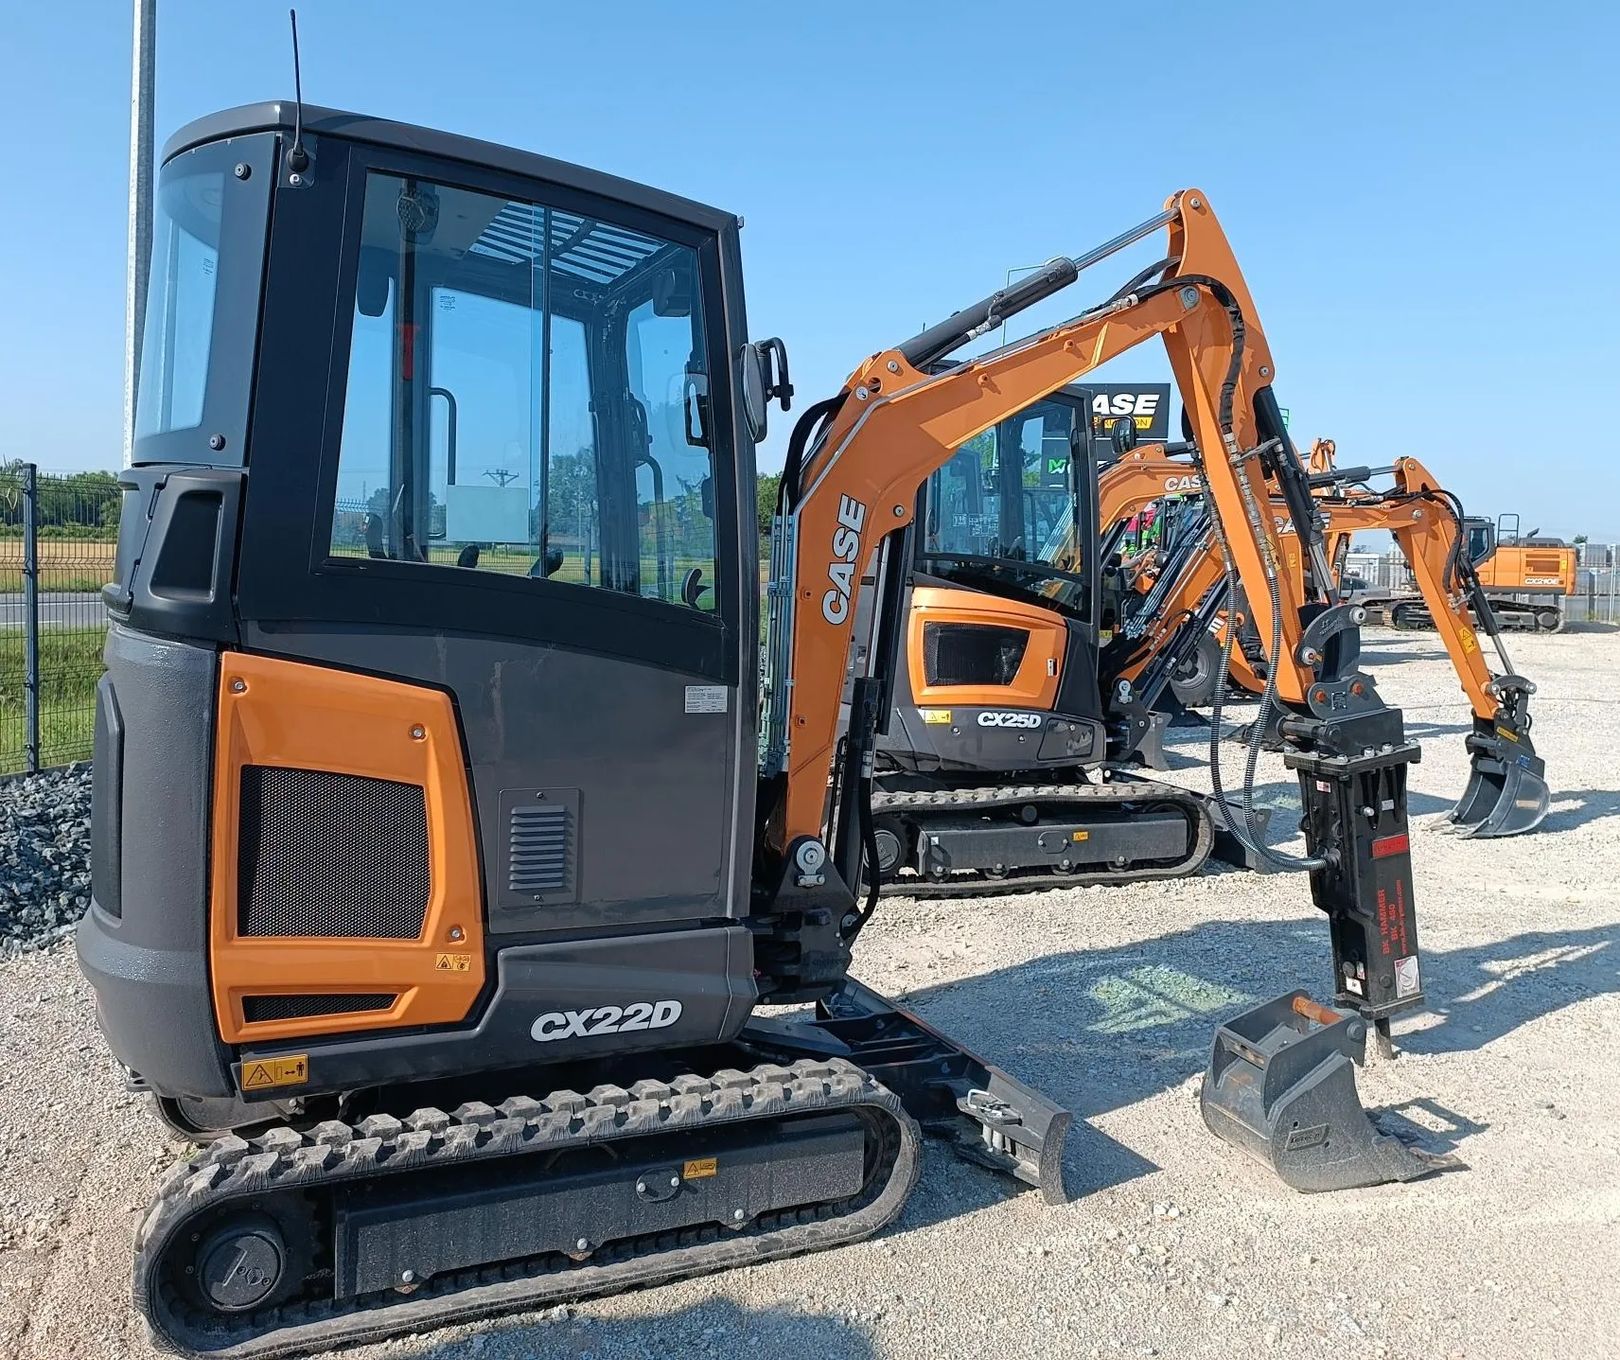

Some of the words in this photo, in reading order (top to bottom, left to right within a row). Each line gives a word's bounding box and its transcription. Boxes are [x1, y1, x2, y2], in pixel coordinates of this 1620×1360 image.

[1092, 393, 1160, 415] ASE
[1164, 474, 1202, 492] CAS
[821, 492, 867, 626] CASE
[977, 711, 1042, 729] CX25D
[530, 999, 683, 1042] CX22D
